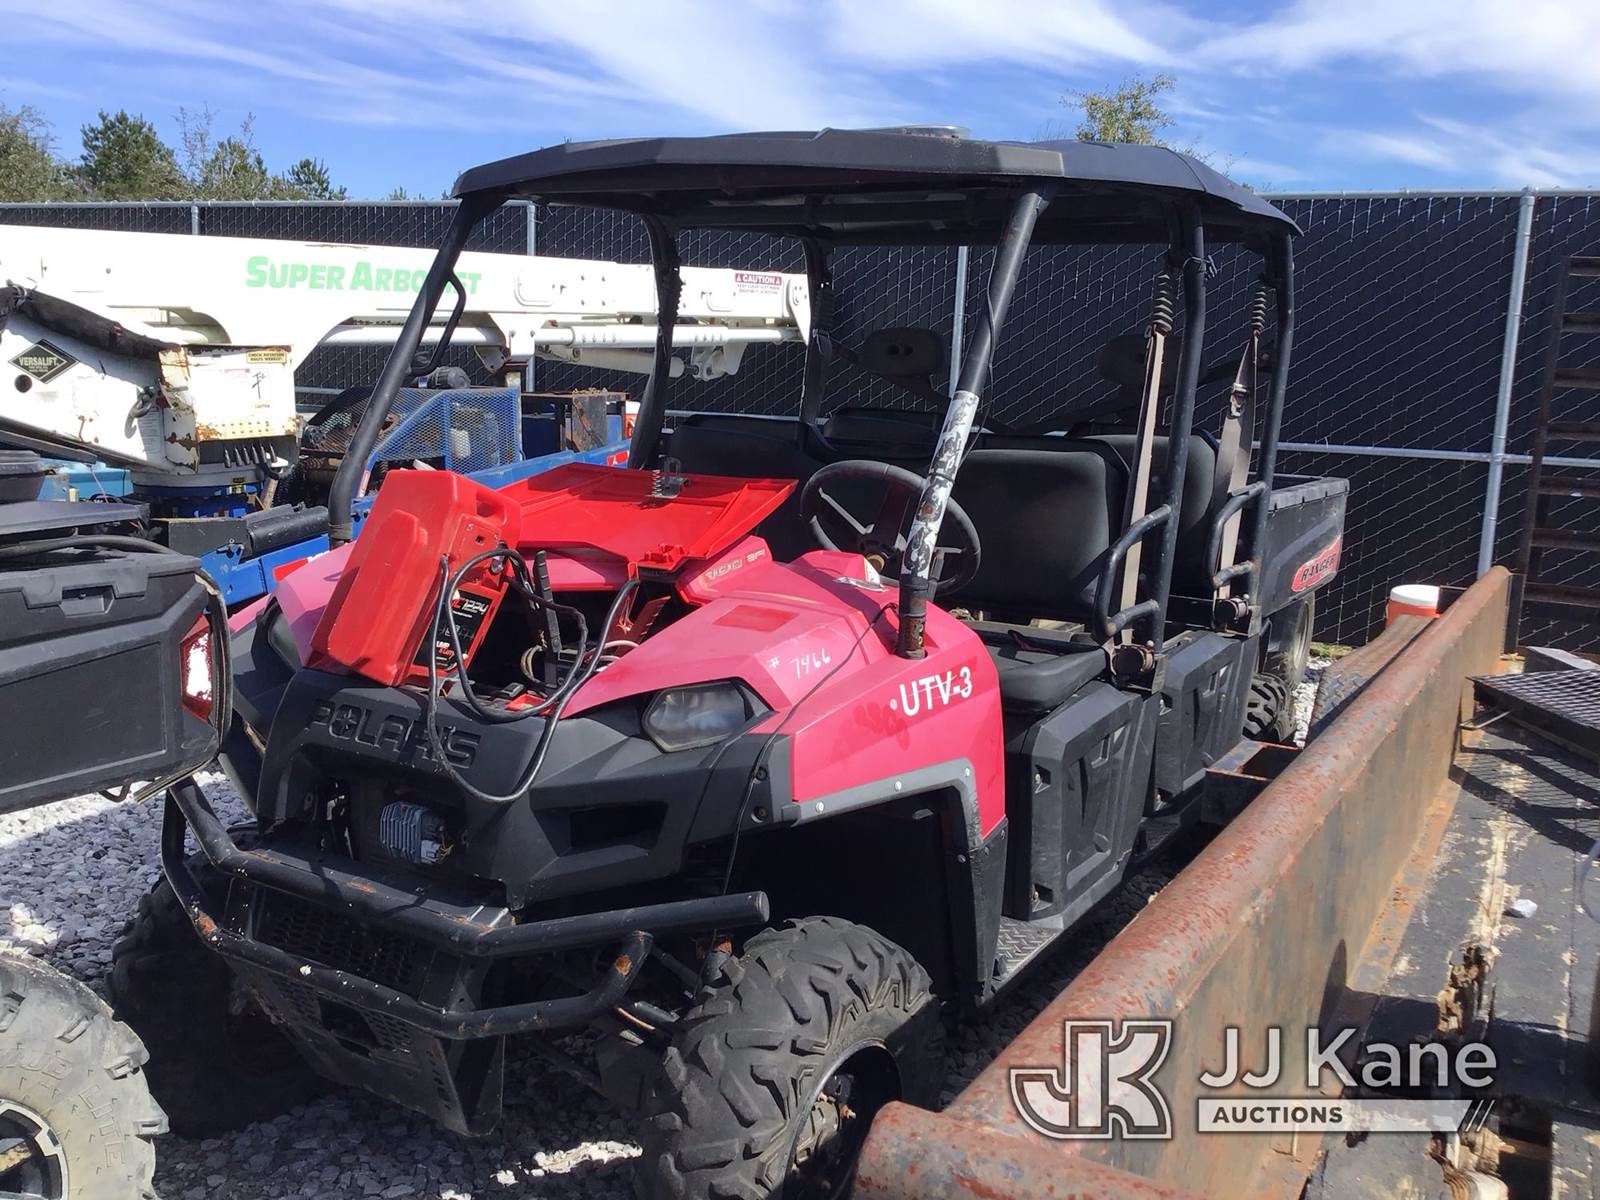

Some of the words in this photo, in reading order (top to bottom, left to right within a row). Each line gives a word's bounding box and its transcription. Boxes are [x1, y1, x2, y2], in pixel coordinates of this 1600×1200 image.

[246, 256, 345, 290] SUPER
[350, 261, 482, 295] ARBOT
[742, 274, 775, 284] CAUTION
[789, 648, 832, 680] 7466
[899, 665, 973, 717] UTV-3
